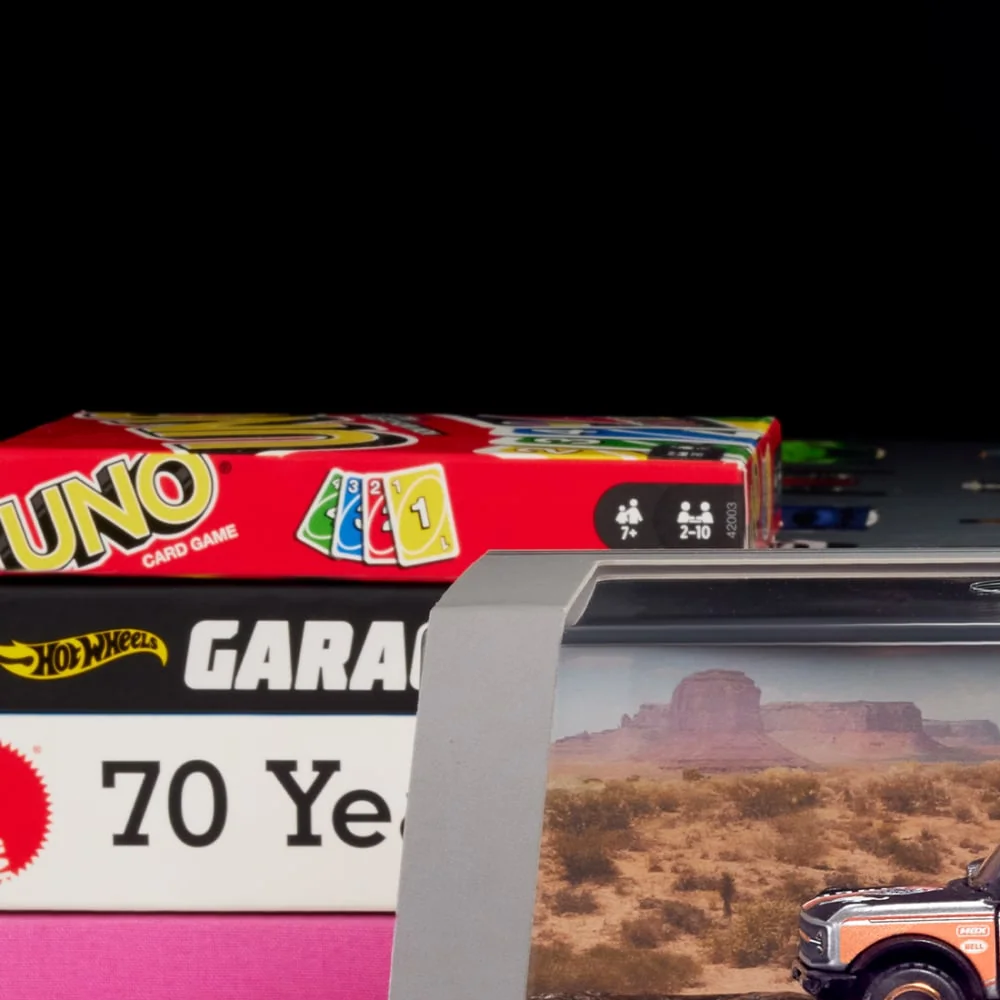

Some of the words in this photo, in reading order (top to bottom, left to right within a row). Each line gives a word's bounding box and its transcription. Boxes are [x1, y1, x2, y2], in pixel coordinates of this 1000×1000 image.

[348, 479, 359, 493] 3
[370, 480, 381, 495] 2
[0, 453, 217, 572] UNO
[410, 495, 431, 530] 1
[726, 502, 738, 540] 42003
[142, 542, 188, 569] CARD
[190, 523, 239, 552] GAME
[620, 525, 638, 541] 7+
[679, 525, 711, 540] 2-10
[101, 759, 229, 848] 70
[265, 759, 411, 849] Ye
